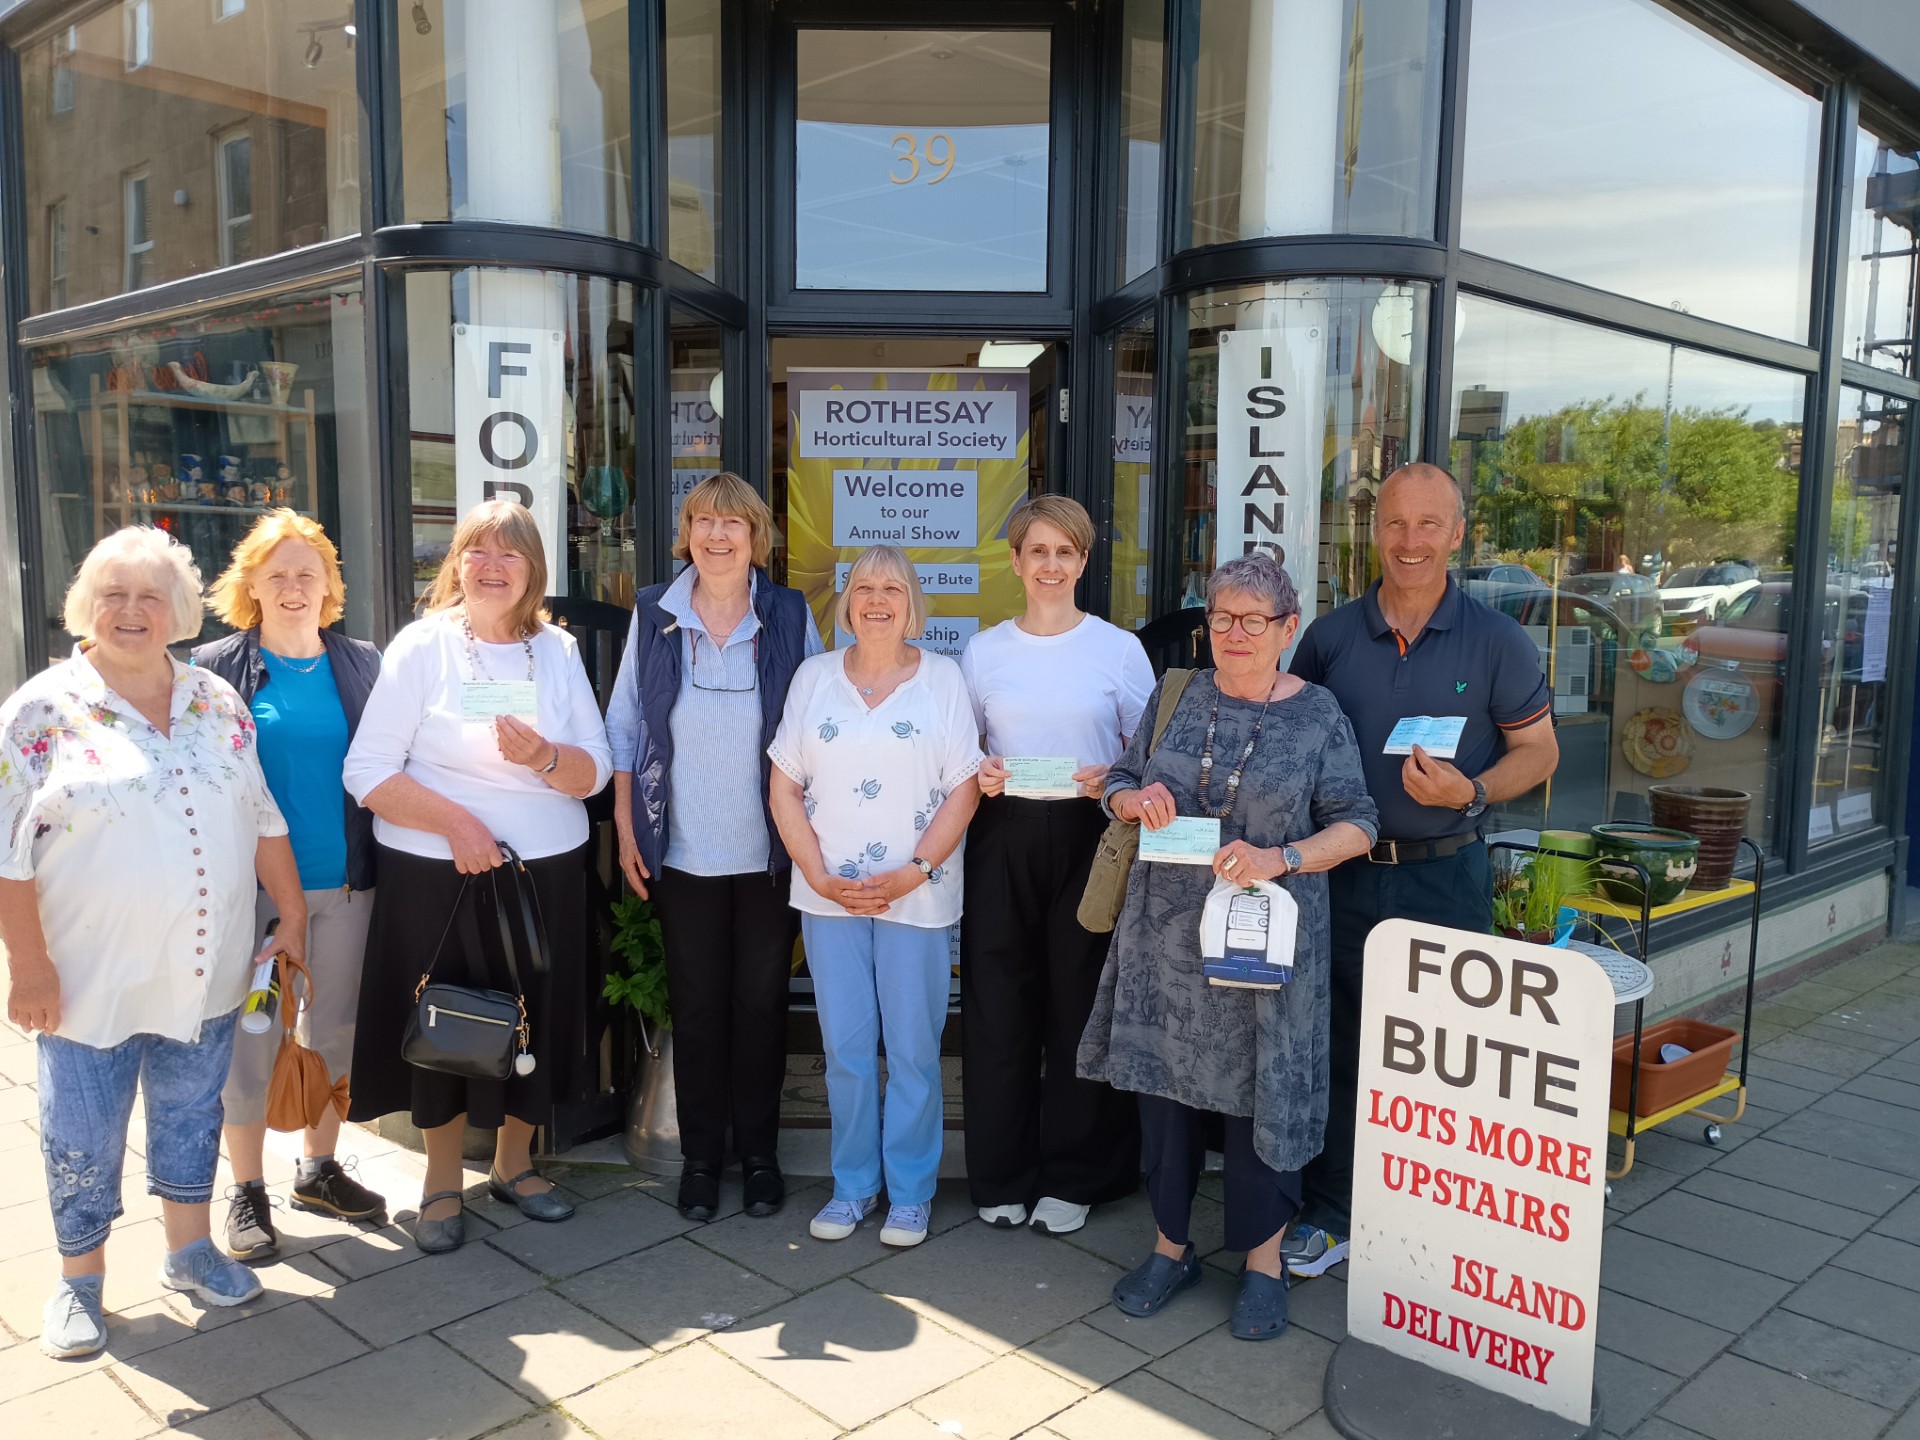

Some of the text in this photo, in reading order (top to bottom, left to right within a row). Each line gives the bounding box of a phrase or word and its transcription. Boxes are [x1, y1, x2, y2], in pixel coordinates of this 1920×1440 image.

[891, 133, 955, 185] 39
[826, 400, 994, 424] ROTHESAY
[813, 430, 1008, 451] Horticultural Society
[844, 475, 965, 498] Welcome
[880, 506, 929, 519] to our
[849, 526, 960, 540] Annual Show
[918, 573, 973, 585] or Bute
[1407, 938, 1560, 1026] FOR
[1382, 1015, 1580, 1118] BUTE
[1368, 1089, 1592, 1185] LOTS MORE
[1381, 1152, 1571, 1242] UPSTAIRS
[1451, 1254, 1586, 1331] ISLAND
[1383, 1292, 1555, 1385] DELIVERY
